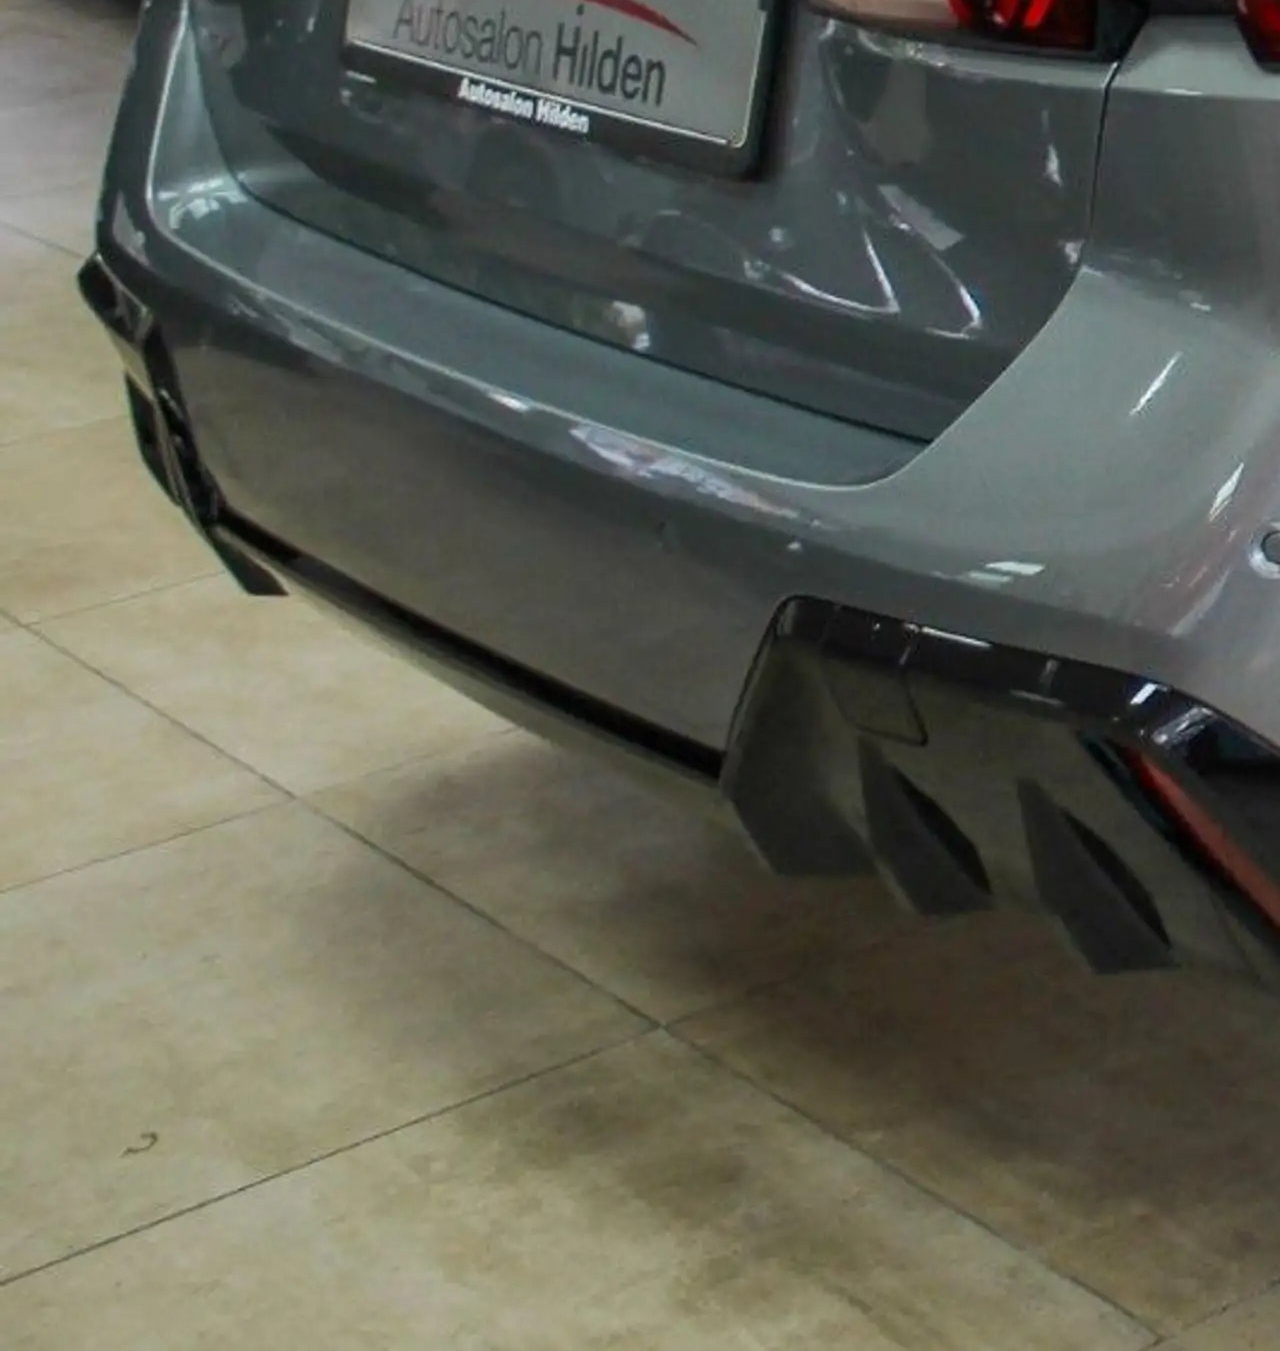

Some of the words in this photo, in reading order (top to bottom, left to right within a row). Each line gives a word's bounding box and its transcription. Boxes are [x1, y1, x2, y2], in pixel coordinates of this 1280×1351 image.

[552, 4, 667, 108] Hilden
[457, 77, 533, 121] Autosalon
[534, 96, 591, 135] Hilden
